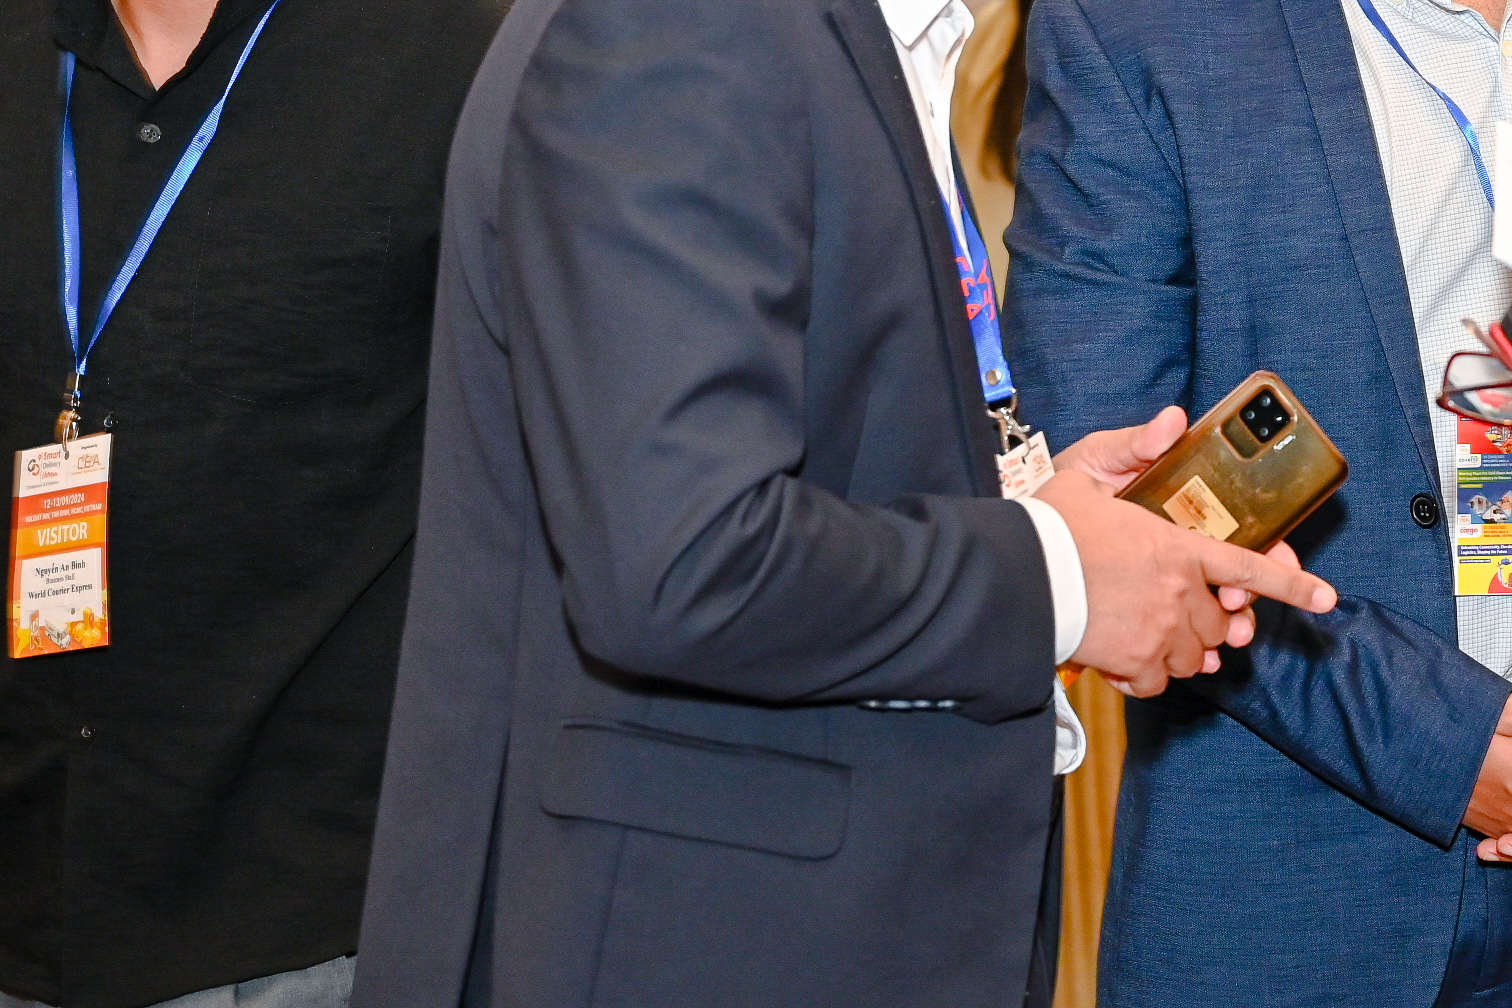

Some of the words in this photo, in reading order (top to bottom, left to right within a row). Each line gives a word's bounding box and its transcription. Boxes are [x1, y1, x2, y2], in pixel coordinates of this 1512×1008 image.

[43, 450, 61, 461] Smart
[42, 461, 61, 470] Delivery
[43, 492, 85, 509] 12-13/09/2024
[37, 521, 89, 547] VISITOR
[60, 563, 69, 573] An
[28, 589, 46, 600] World
[47, 585, 70, 597] Courier
[71, 582, 93, 595] Express
